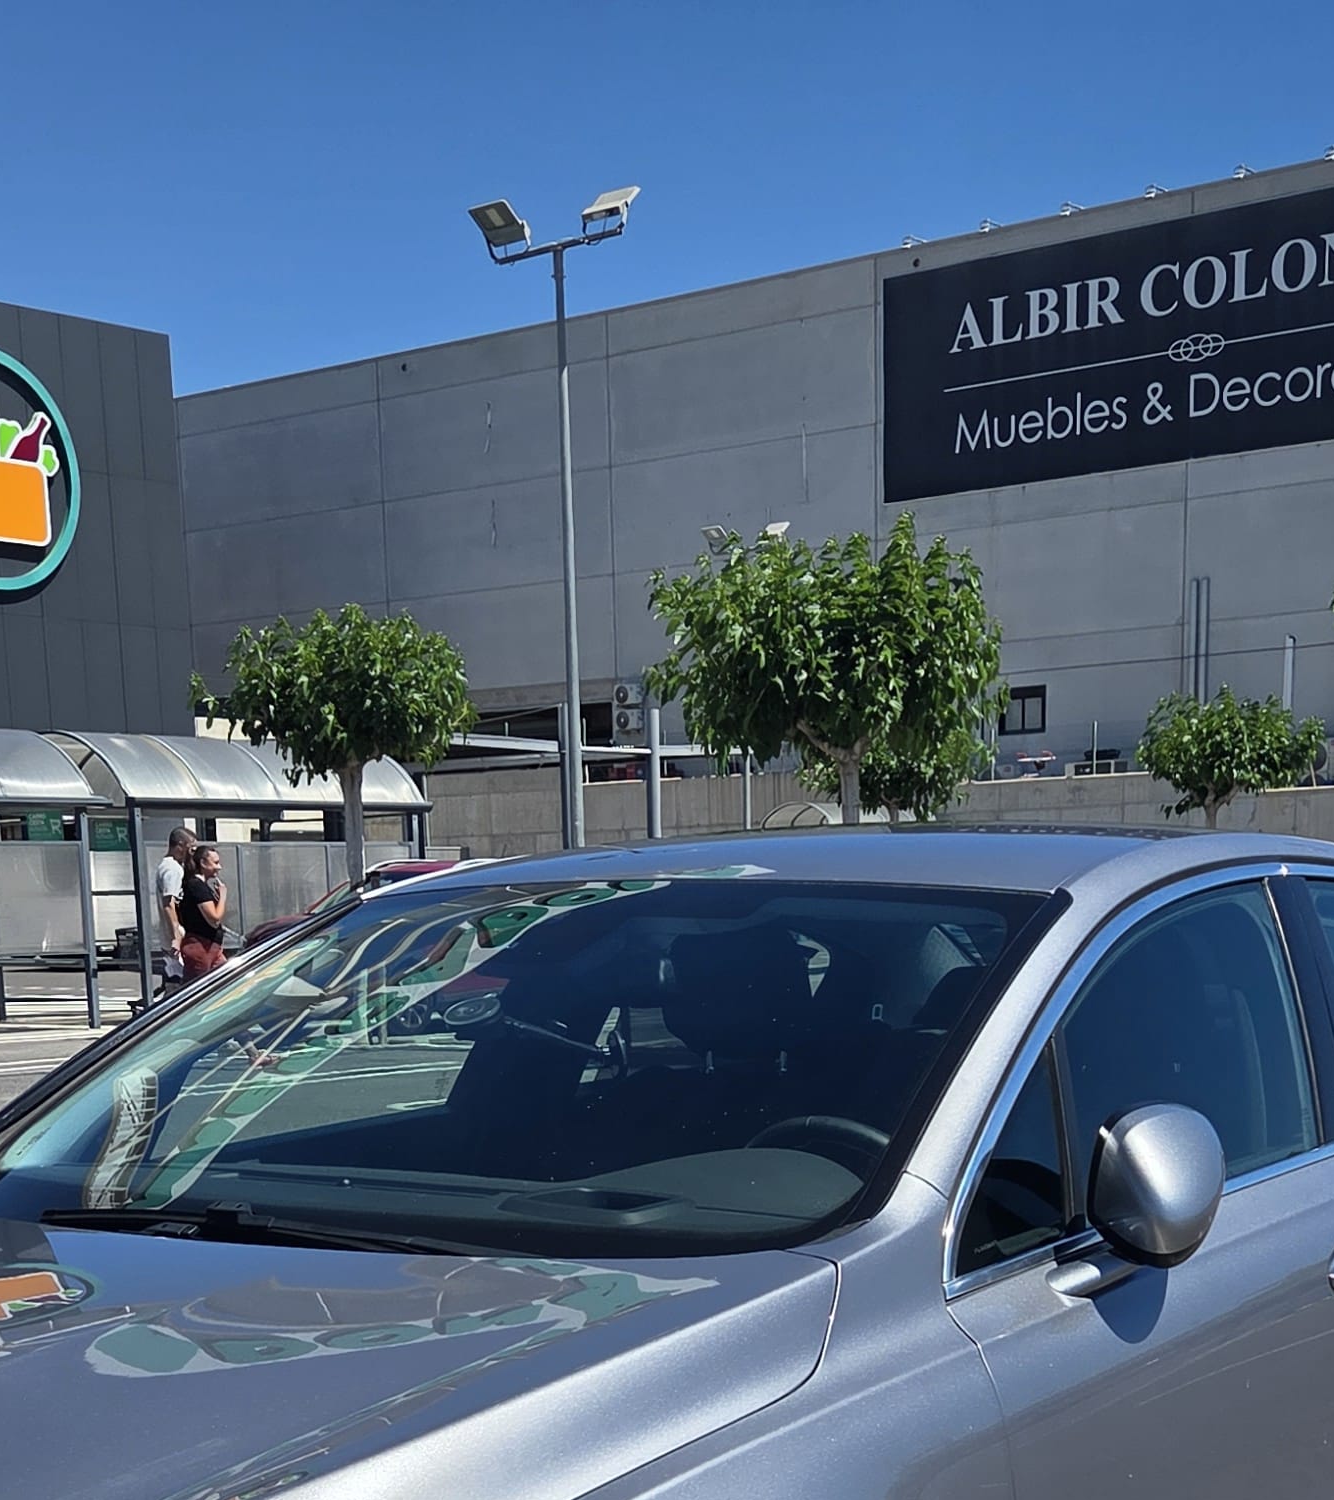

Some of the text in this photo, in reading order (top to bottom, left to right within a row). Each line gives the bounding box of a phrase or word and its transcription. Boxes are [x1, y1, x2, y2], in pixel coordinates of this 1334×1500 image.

[948, 276, 1125, 355] ALBIR
[954, 390, 1128, 455] Muebles
[1142, 382, 1174, 426] &
